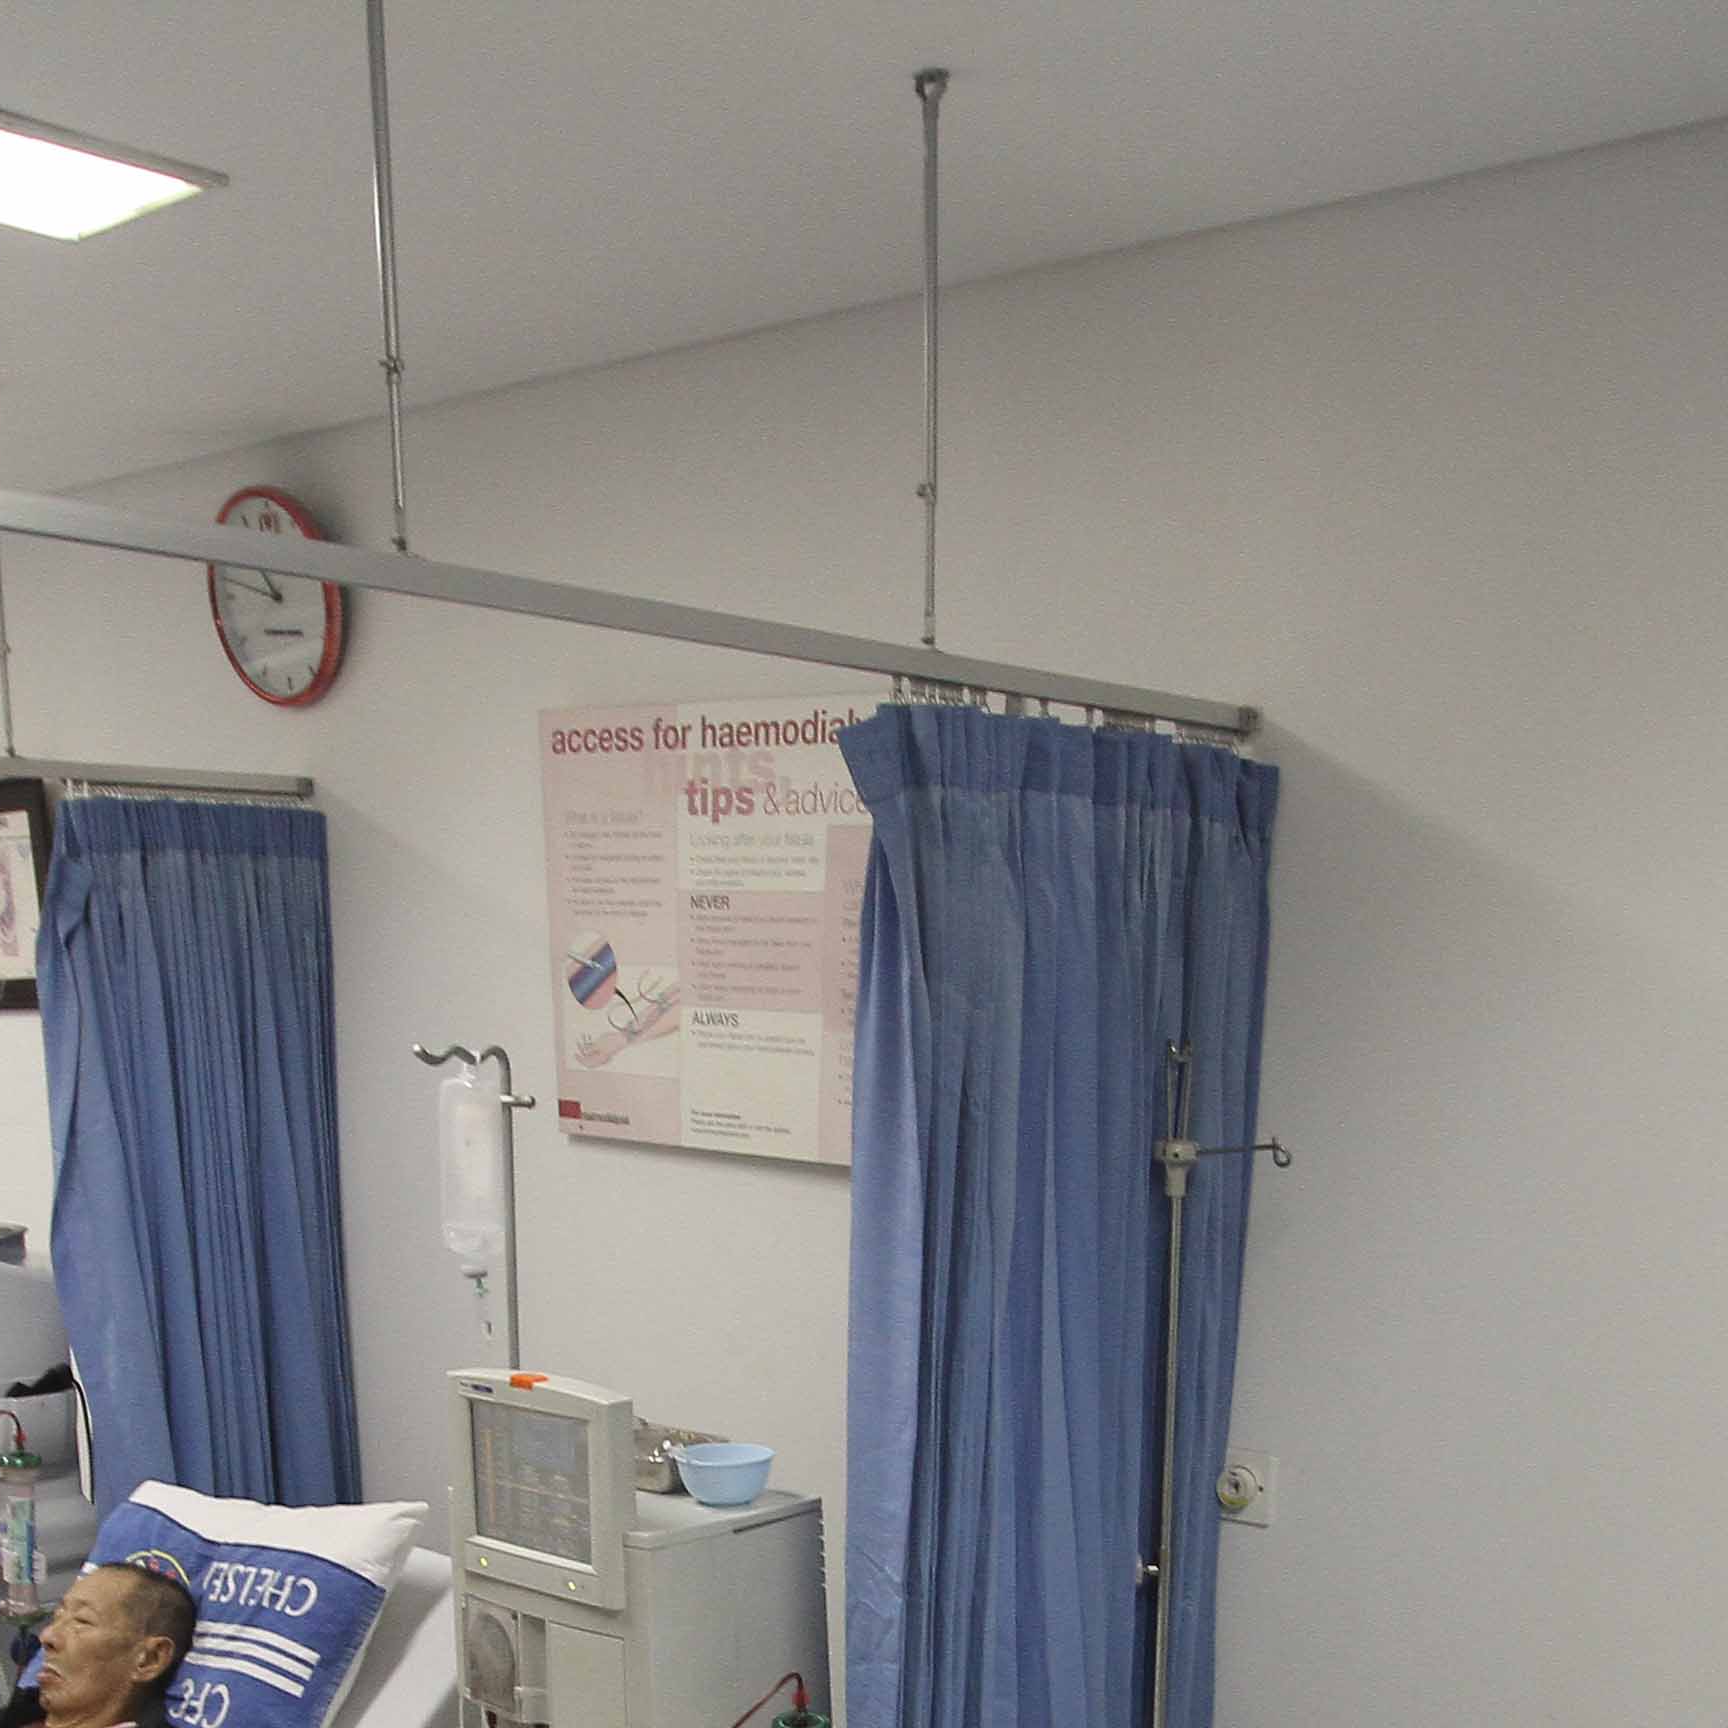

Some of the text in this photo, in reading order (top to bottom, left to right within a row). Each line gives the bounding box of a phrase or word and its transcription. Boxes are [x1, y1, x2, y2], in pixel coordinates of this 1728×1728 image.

[551, 709, 862, 754] access for haemodial
[684, 779, 756, 824] tips
[763, 782, 780, 816] &
[689, 895, 731, 910] NEVER
[691, 1011, 740, 1028] ALWAYS
